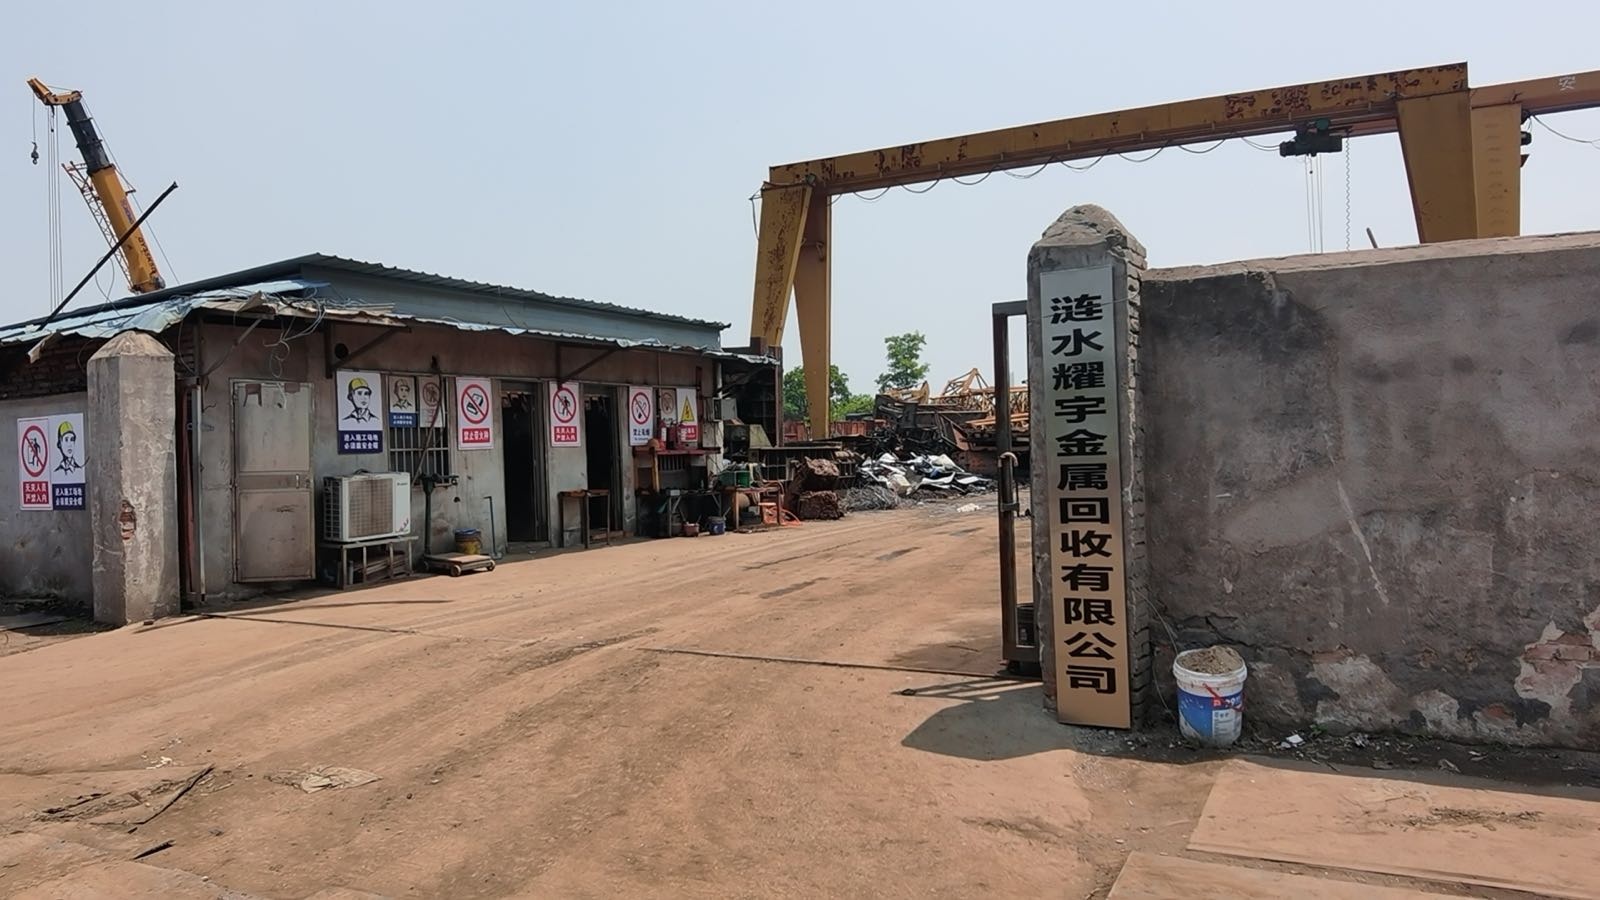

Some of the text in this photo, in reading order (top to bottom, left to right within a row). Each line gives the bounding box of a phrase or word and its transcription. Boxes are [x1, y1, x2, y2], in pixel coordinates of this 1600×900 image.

[1050, 294, 1118, 695] 涟水耀宇金属回收有限公司
